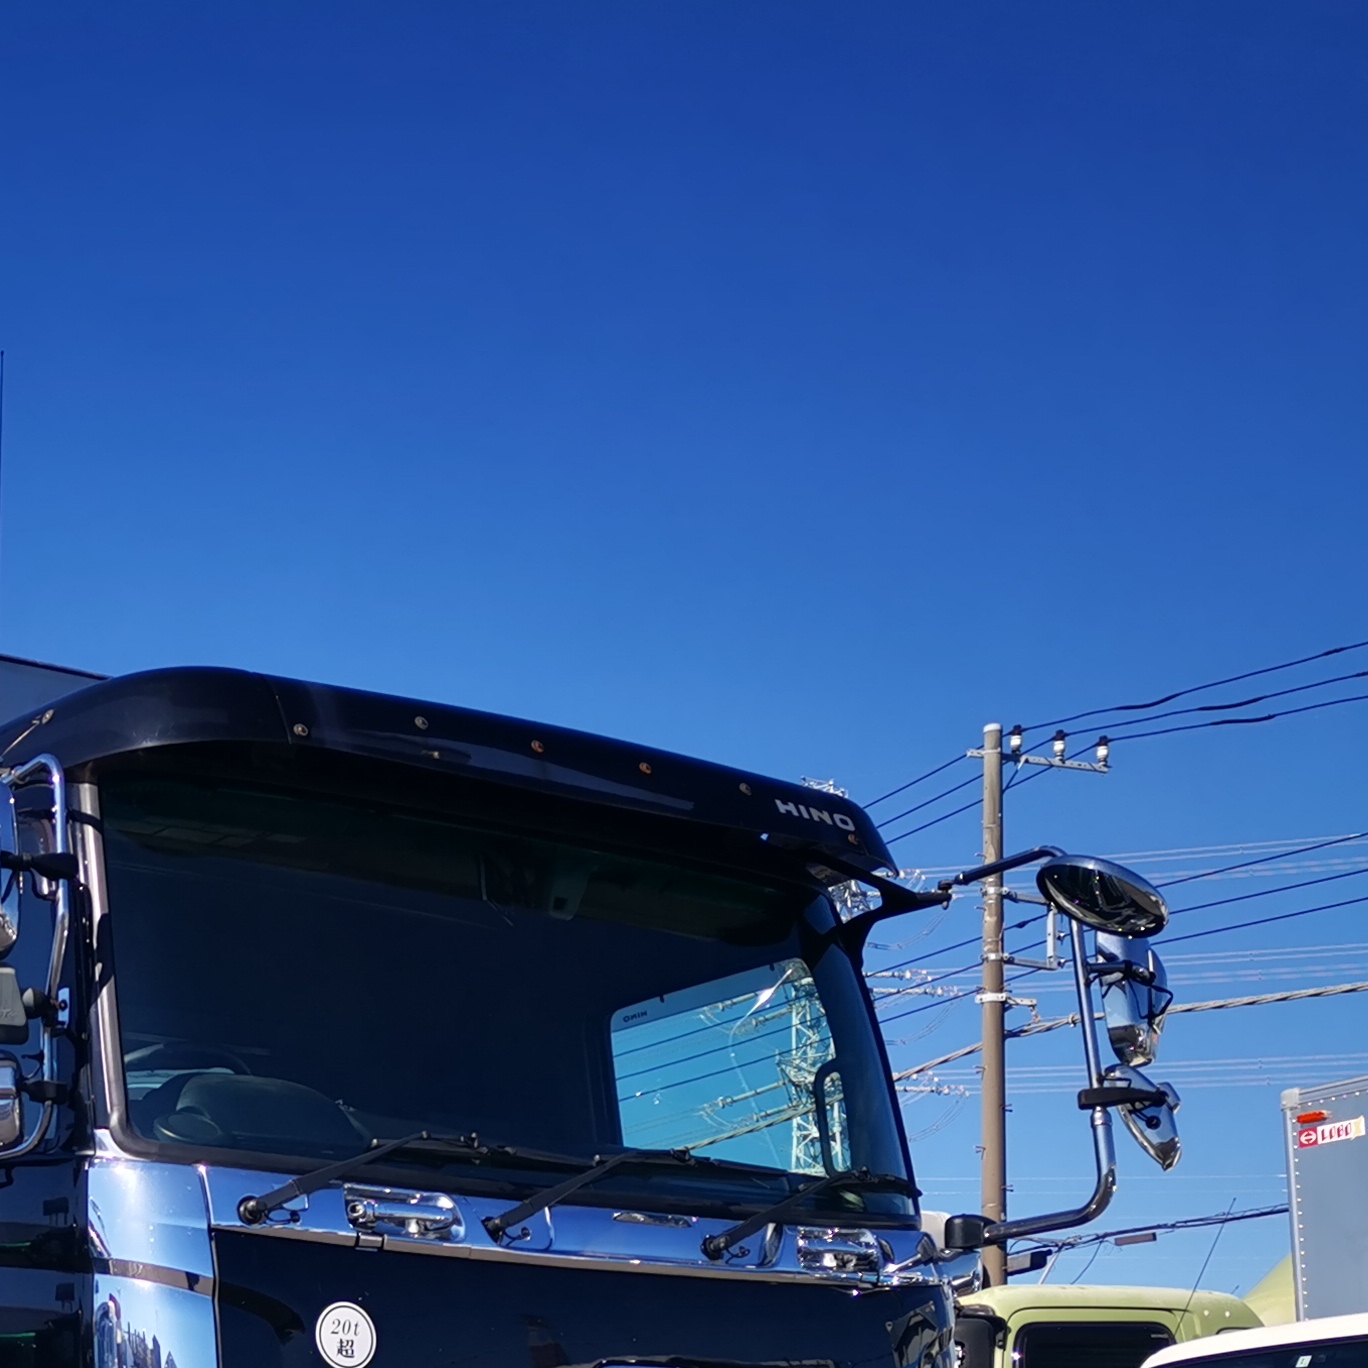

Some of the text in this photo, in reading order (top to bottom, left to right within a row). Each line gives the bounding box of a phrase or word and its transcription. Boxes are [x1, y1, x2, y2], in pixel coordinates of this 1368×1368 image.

[774, 798, 856, 832] HINO
[330, 1318, 361, 1337] 20t
[336, 1338, 355, 1359] 超
